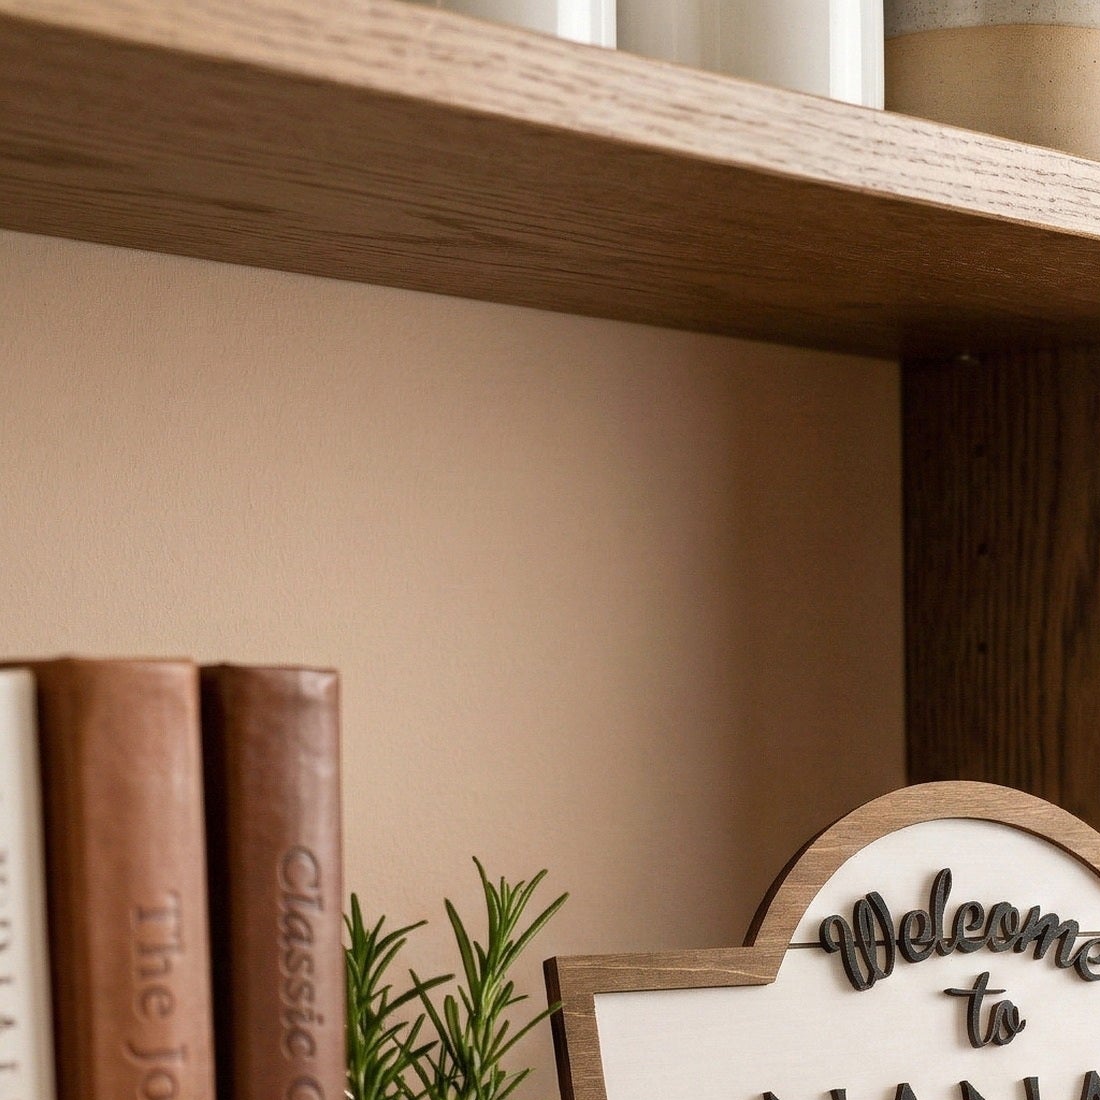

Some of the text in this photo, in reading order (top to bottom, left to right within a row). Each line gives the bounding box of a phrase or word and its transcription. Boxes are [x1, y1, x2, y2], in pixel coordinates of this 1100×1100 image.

[132, 891, 184, 1019] The
[279, 845, 325, 1059] Classic
[943, 972, 1026, 1048] to
